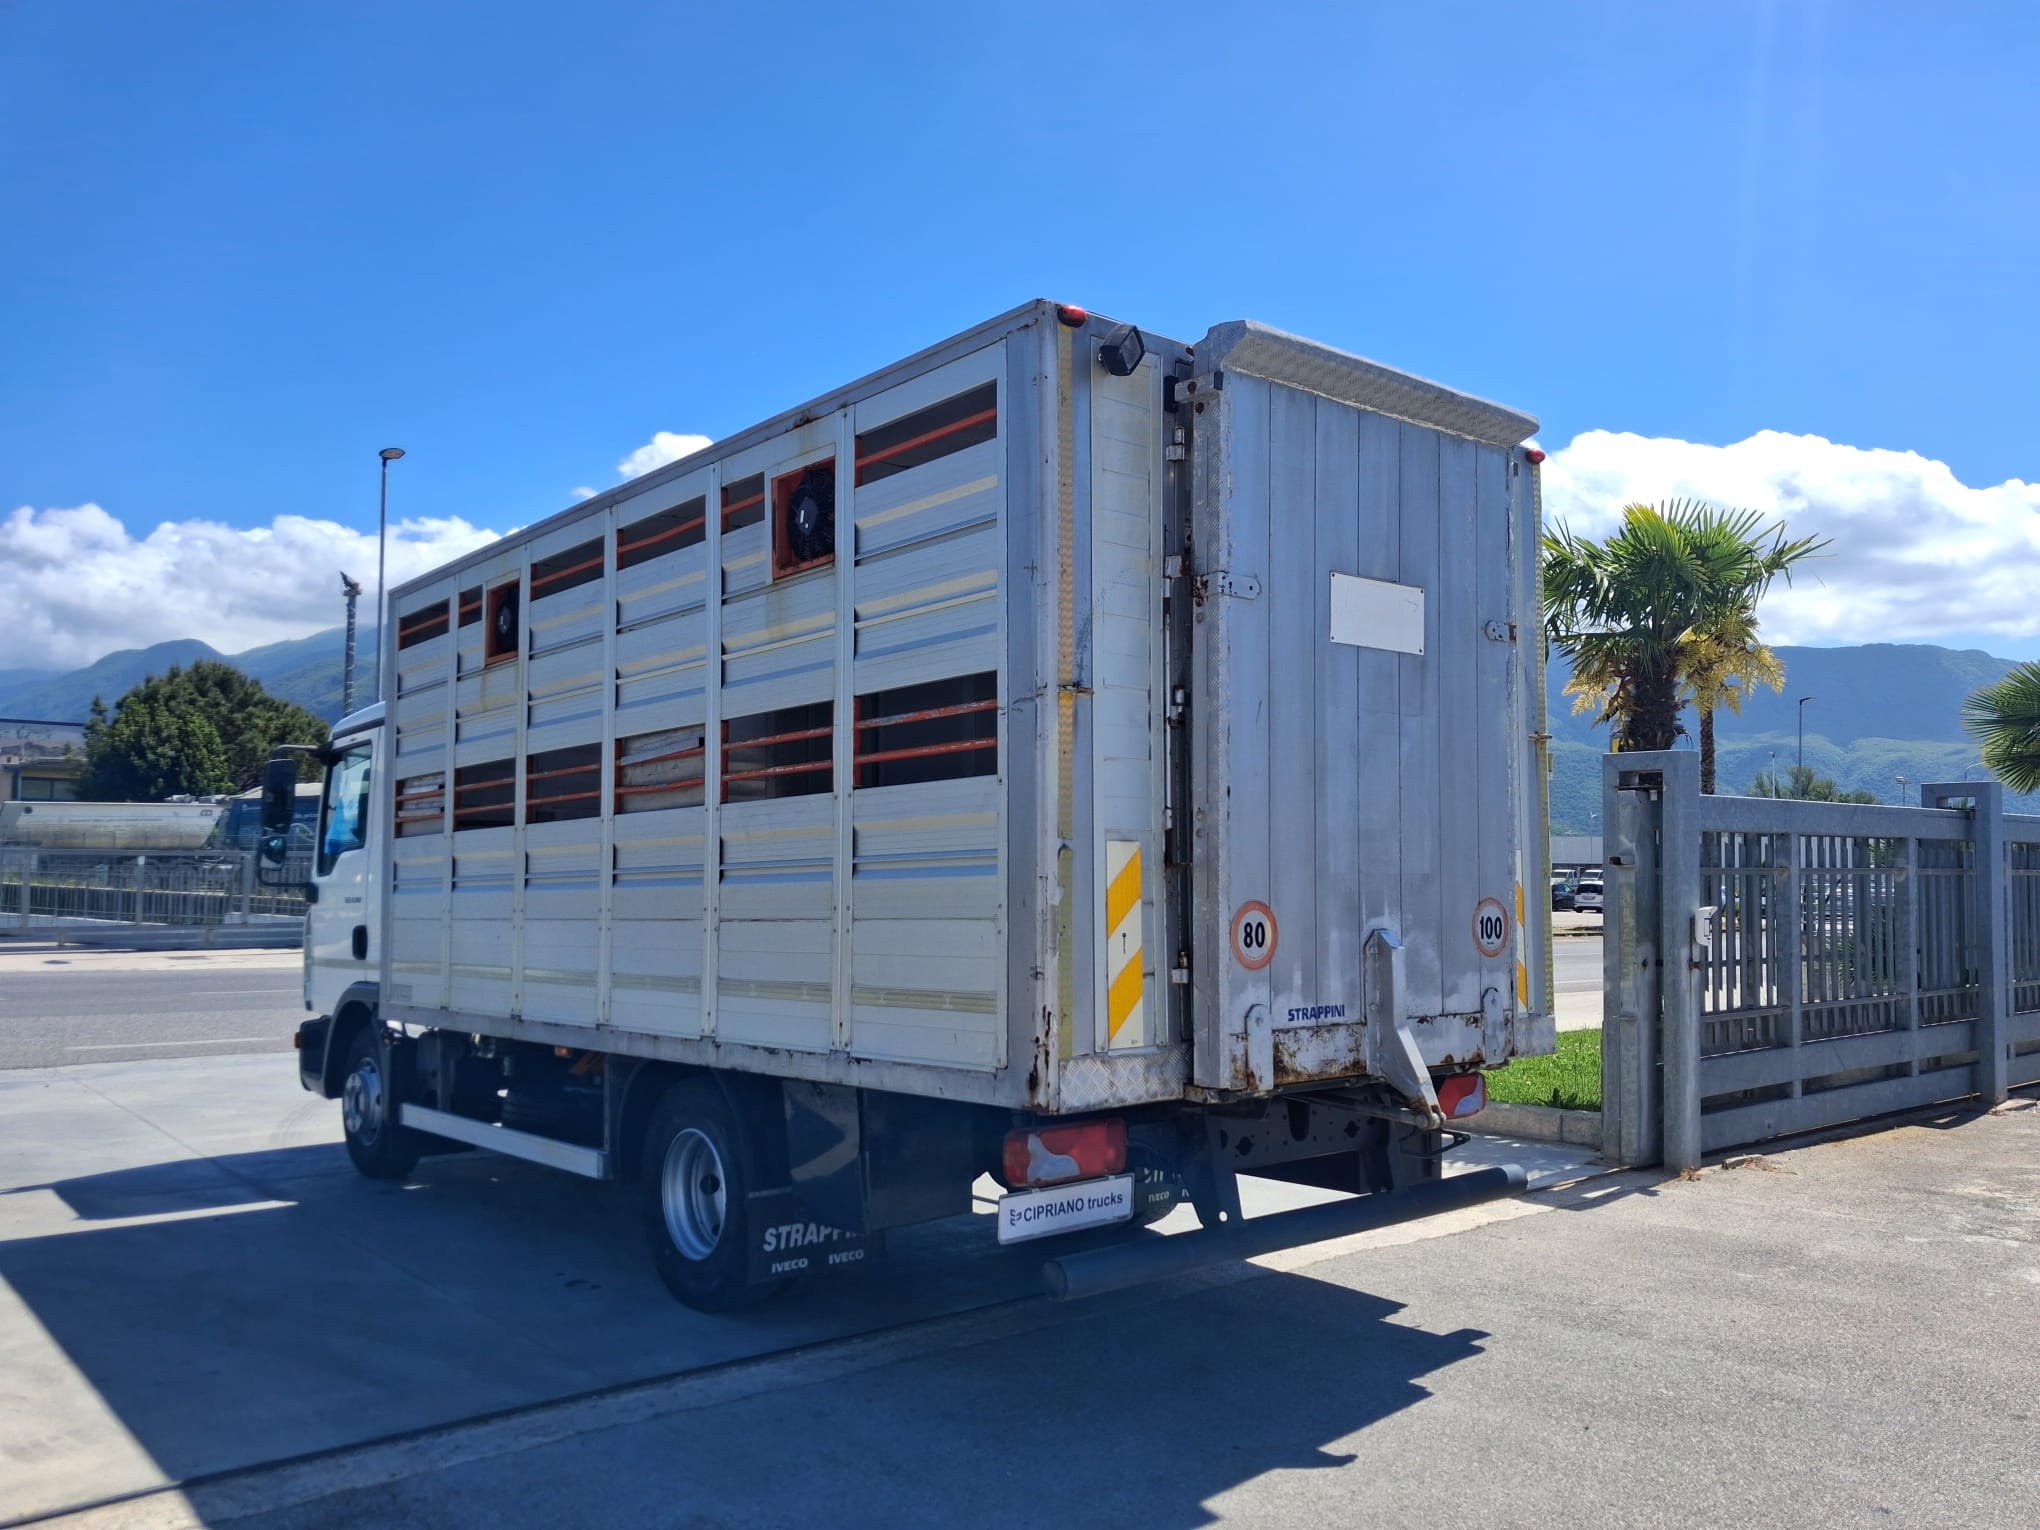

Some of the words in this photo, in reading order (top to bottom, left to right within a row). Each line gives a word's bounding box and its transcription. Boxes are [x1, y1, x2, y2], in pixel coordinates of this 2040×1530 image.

[1243, 921, 1266, 949] 80
[1479, 916, 1503, 940] 100
[1287, 1004, 1346, 1023] STRAPPINI
[1023, 1197, 1085, 1222] CIPRIANO
[1087, 1191, 1124, 1210] trucks
[769, 1257, 808, 1274] IVECO
[827, 1249, 864, 1265] IVECO
